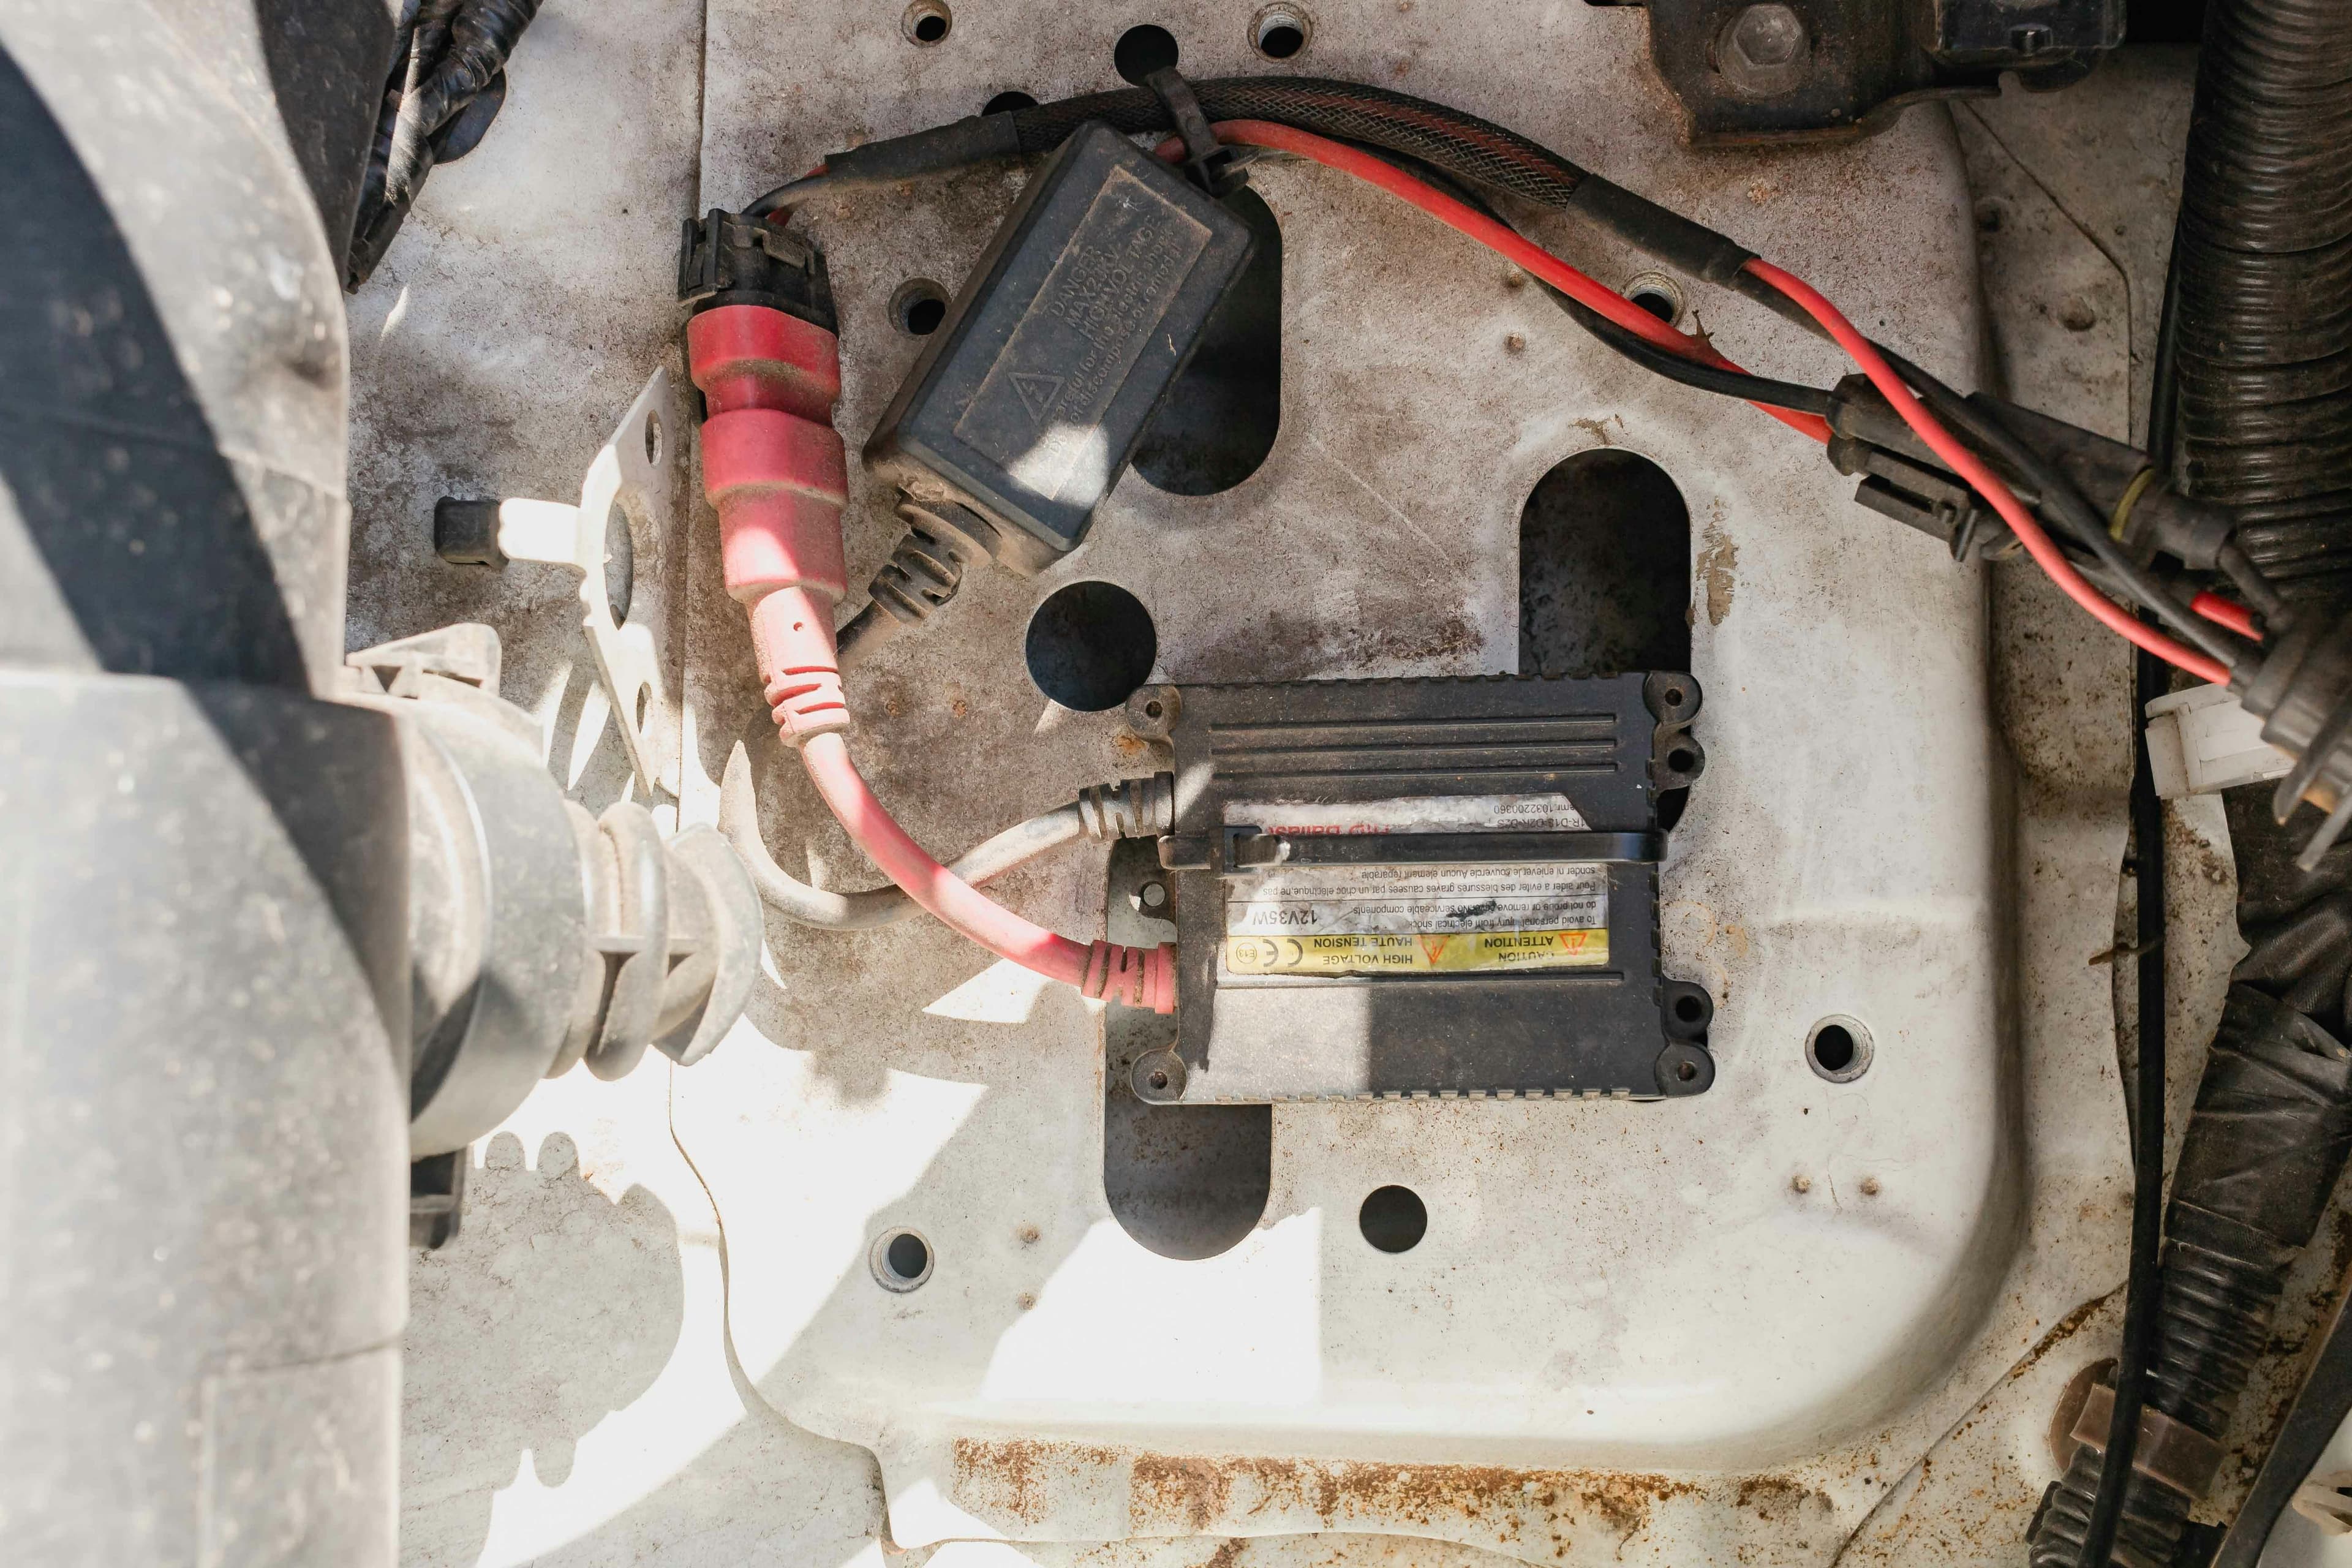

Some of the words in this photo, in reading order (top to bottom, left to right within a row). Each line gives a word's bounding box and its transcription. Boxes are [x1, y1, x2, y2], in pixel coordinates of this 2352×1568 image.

[1047, 243, 1102, 318] DANGER
[1403, 870, 1438, 879] element
[1440, 869, 1468, 879] Aucun
[1566, 866, 1595, 876] sonder
[1262, 886, 1278, 896] pas
[1336, 886, 1356, 896] choc
[1371, 883, 1385, 894] par
[1388, 884, 1423, 893] causees
[1425, 882, 1454, 892] graves
[1457, 884, 1498, 893] blessures
[1500, 883, 1515, 893] des
[1518, 883, 1542, 892] eviter
[1552, 883, 1572, 892] aider
[1575, 881, 1596, 891] Pour
[1406, 905, 1454, 914] serviceable
[1497, 903, 1529, 911] remove
[1570, 902, 1583, 911] not
[1585, 901, 1596, 910] do
[1251, 909, 1317, 924] 12V35W
[1561, 916, 1584, 925] avoid
[1586, 915, 1596, 924] To
[1434, 919, 1472, 929] electrical
[1474, 919, 1494, 929] from
[1521, 916, 1558, 928] personal
[1313, 937, 1366, 947] TENSION
[1370, 937, 1412, 946] HAUTE
[1483, 935, 1553, 948] ATTENTION
[1322, 954, 1378, 965] VOLTAGE
[1382, 954, 1412, 964] HIGH
[1498, 951, 1553, 962] CAUTION
